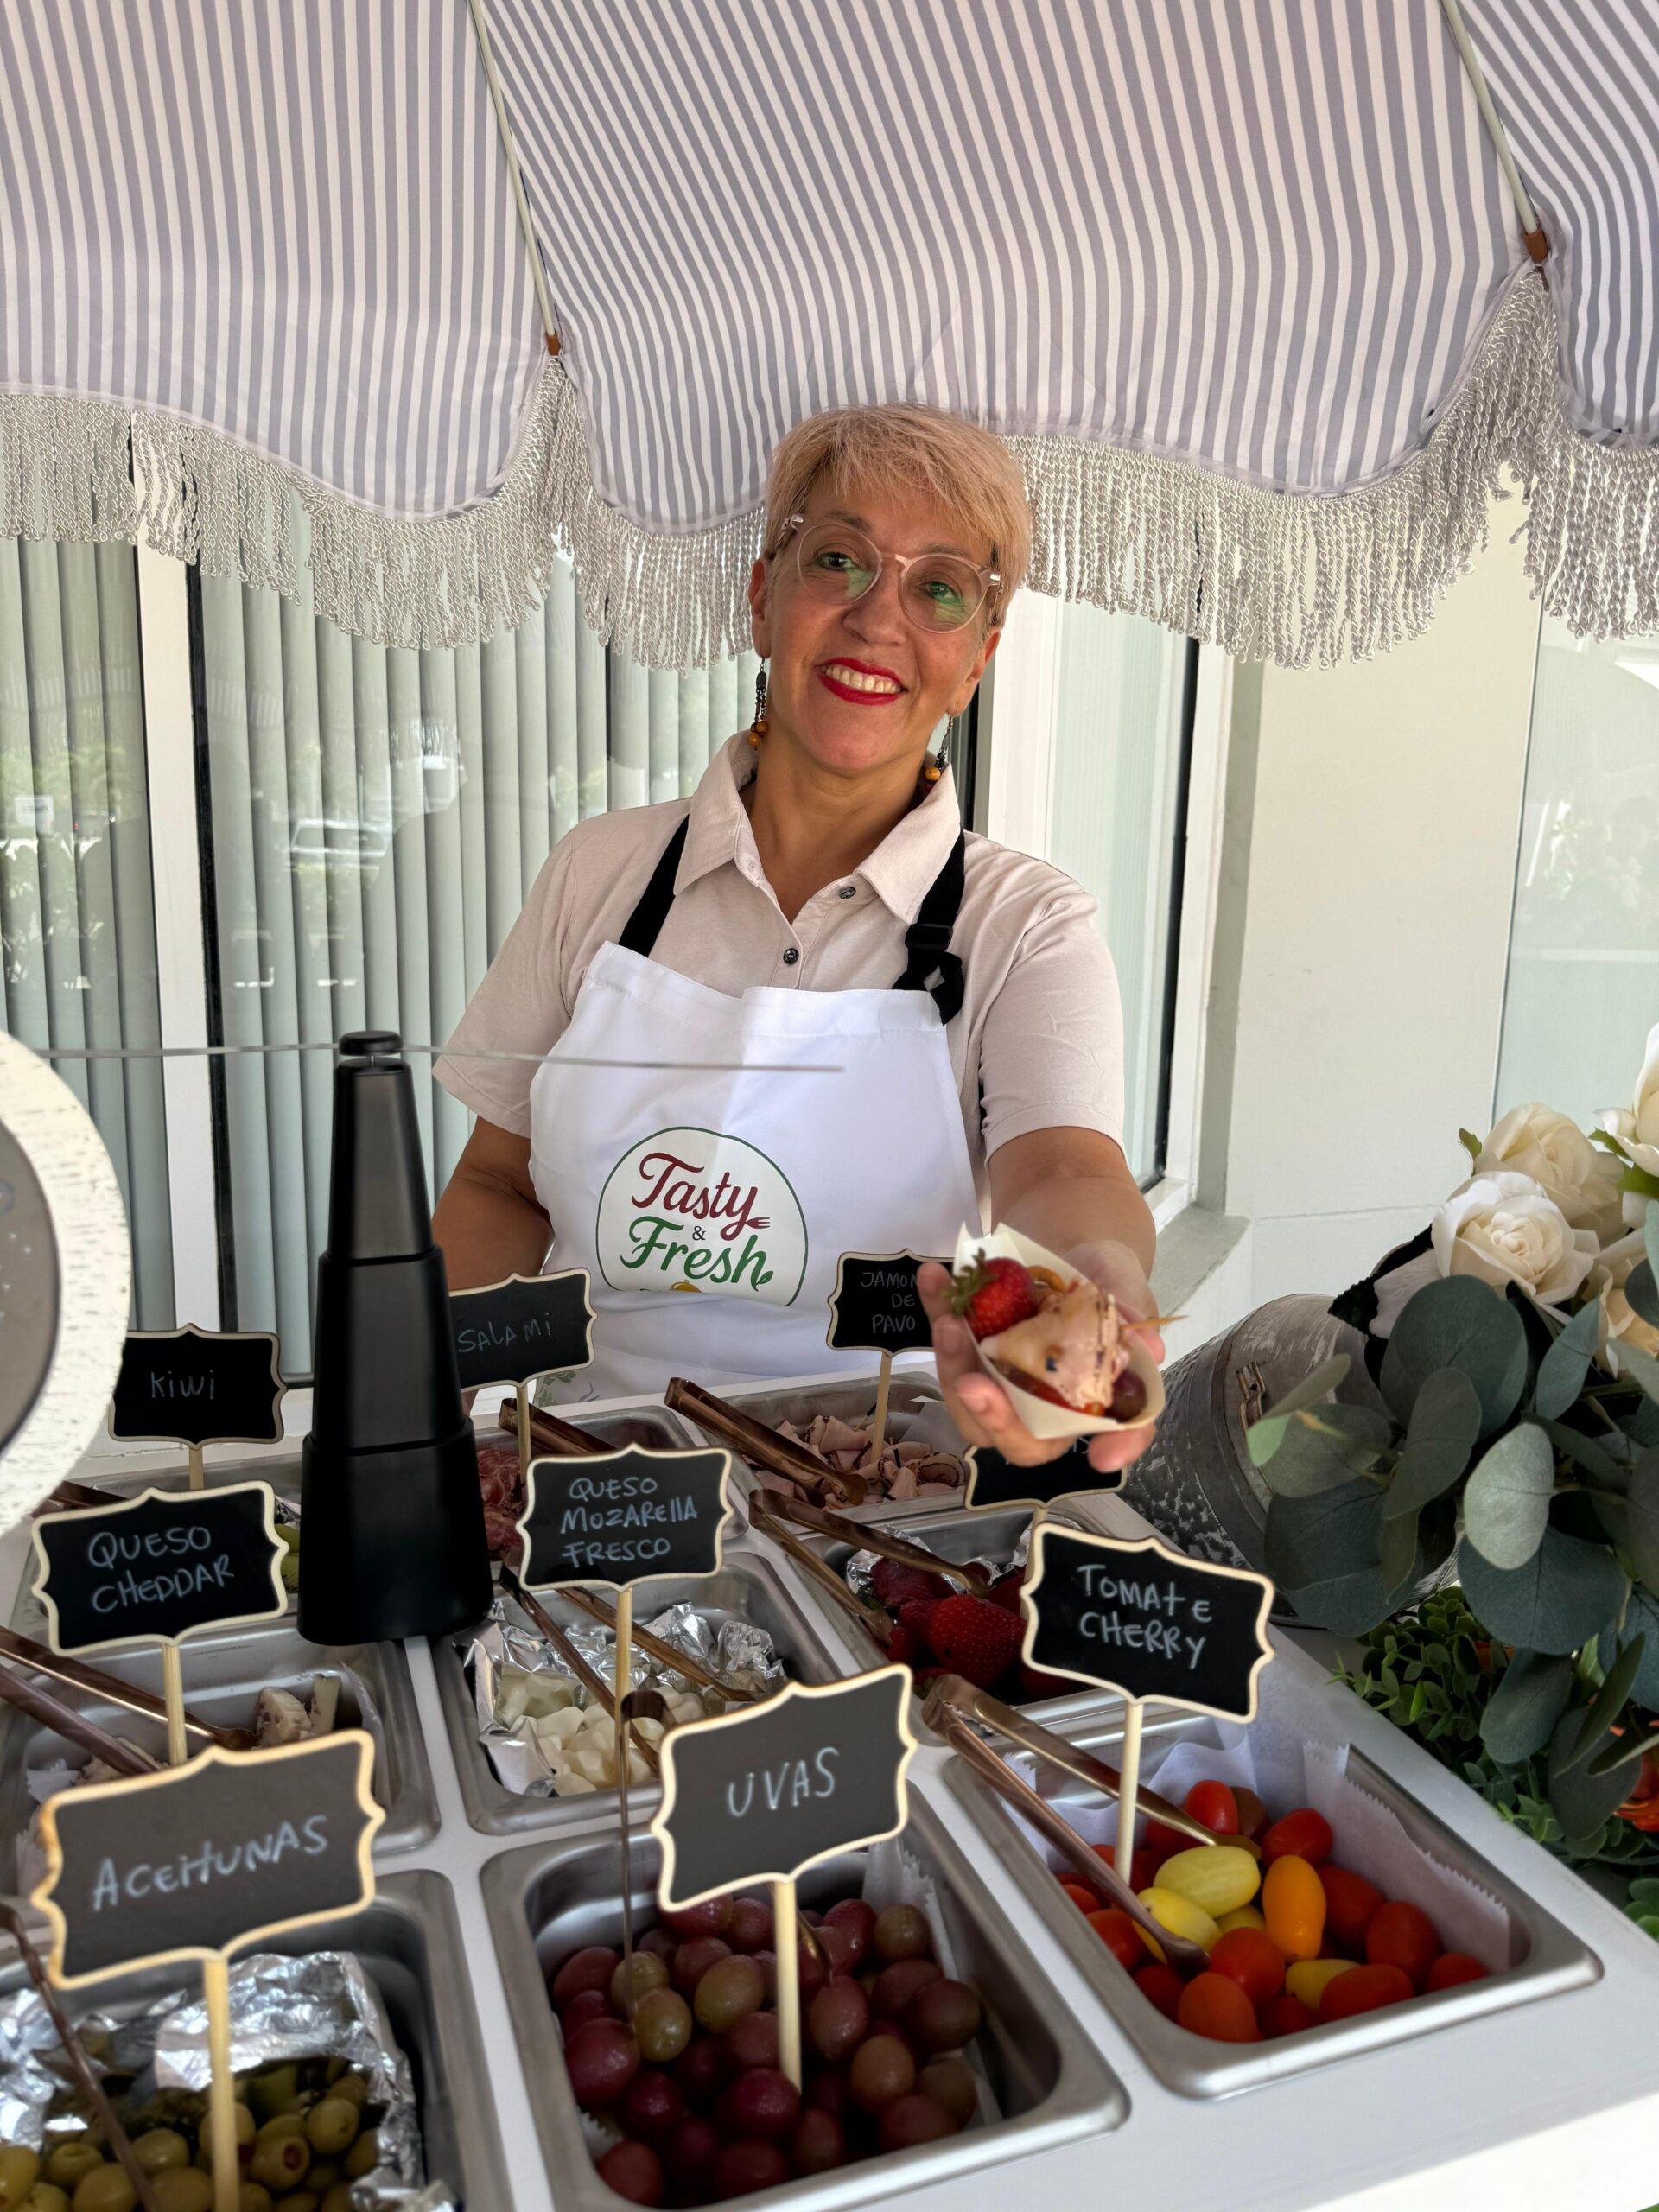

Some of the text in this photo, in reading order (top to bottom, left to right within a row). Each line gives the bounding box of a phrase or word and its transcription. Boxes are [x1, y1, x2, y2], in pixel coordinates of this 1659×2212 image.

[631, 1152, 771, 1241] Tasty
[620, 1215, 774, 1292] Fresh
[692, 1225, 706, 1241] &
[891, 1293, 916, 1308] DE
[871, 1313, 917, 1335] PAVO
[568, 1476, 659, 1502] QUESO
[87, 1526, 212, 1569] QUESO
[562, 1537, 671, 1568] FRESCO
[92, 1554, 235, 1613] CHEDDAR
[1079, 1610, 1205, 1669] CHERRY
[726, 1745, 839, 1817] UVAS
